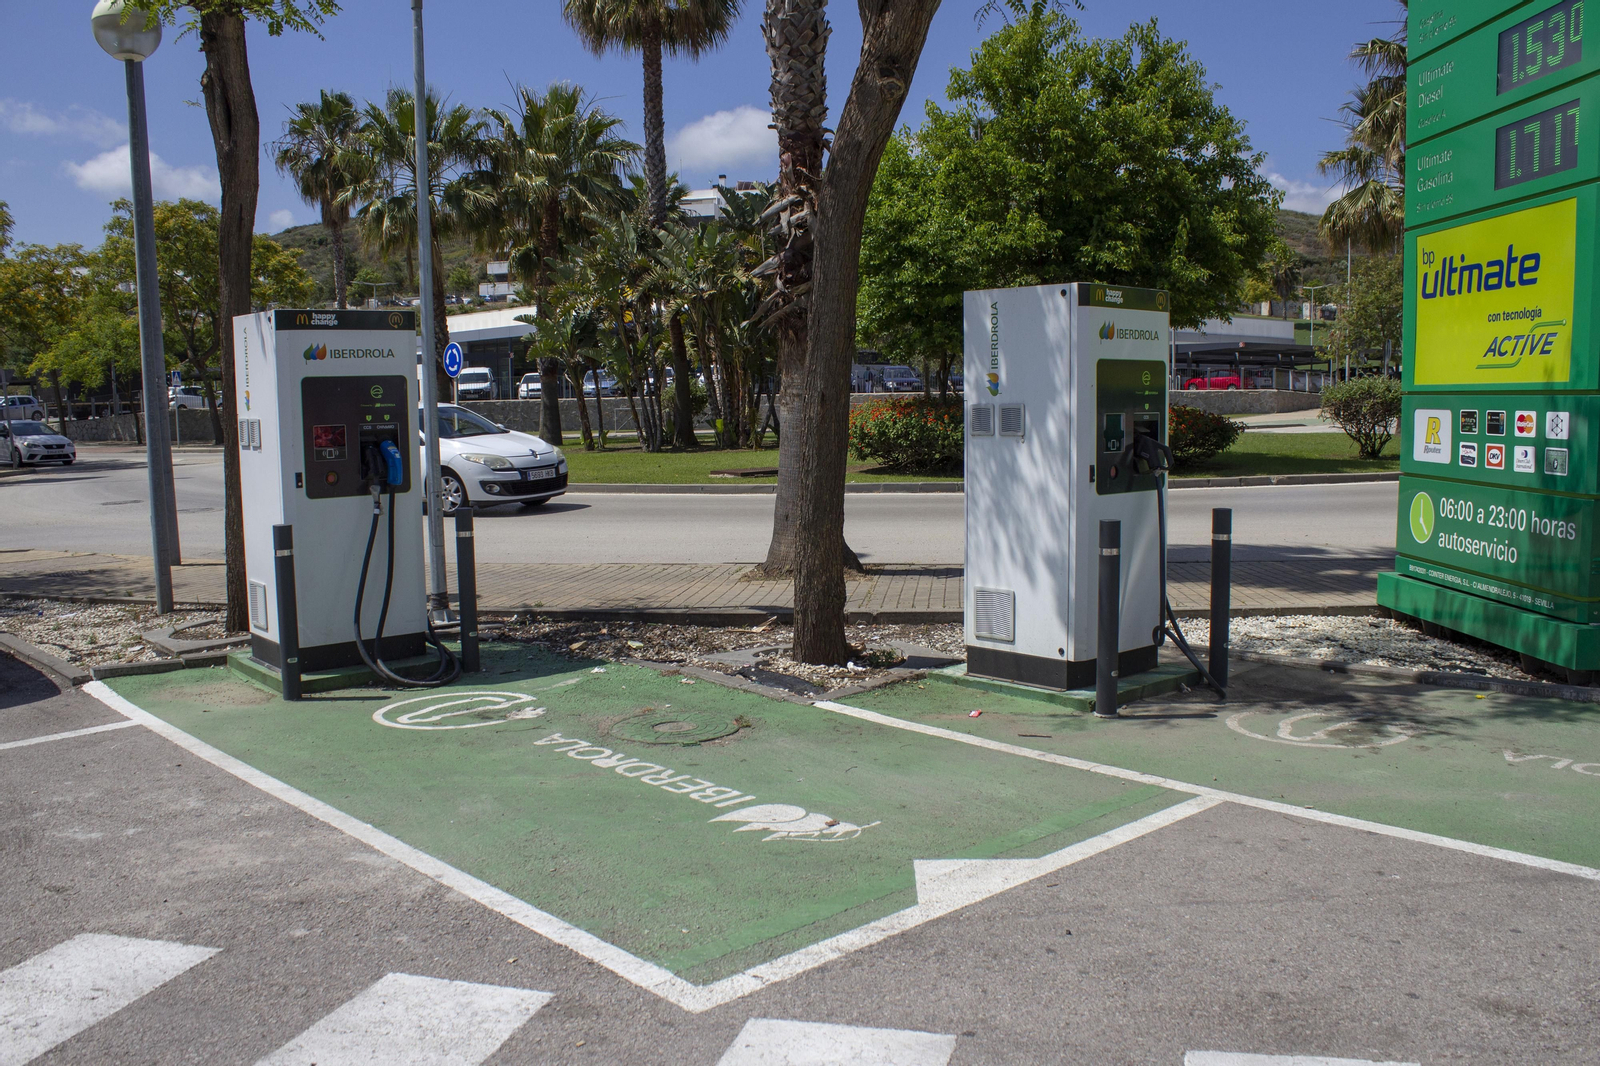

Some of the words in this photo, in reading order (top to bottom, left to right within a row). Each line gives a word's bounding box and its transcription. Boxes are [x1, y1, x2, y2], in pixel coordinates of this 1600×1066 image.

[1418, 59, 1454, 87] Ultimate
[1418, 85, 1444, 108] Diesel
[1417, 149, 1453, 171] Ultimate
[1417, 171, 1453, 192] Gasolina
[1422, 248, 1435, 268] bp
[1421, 244, 1541, 300] ultimate
[1105, 296, 1124, 304] change
[1106, 288, 1122, 298] happy
[311, 318, 338, 327] change
[312, 312, 337, 322] happy
[1488, 311, 1501, 323] con
[1502, 305, 1542, 322] tecnología
[991, 301, 999, 370] IBERDROLA
[1116, 328, 1160, 341] IBERDROLA
[330, 348, 395, 359] IBERDROLA
[1482, 332, 1558, 358] ACTIVE
[1423, 445, 1442, 455] Routex
[1439, 497, 1473, 522] 06:00
[1476, 507, 1484, 524] a
[1488, 505, 1526, 531] 23:00
[1531, 511, 1576, 540] horas
[1438, 531, 1518, 564] autoservicio
[1534, 597, 1555, 609] SEVILLA
[533, 733, 756, 808] IBERDROLA
